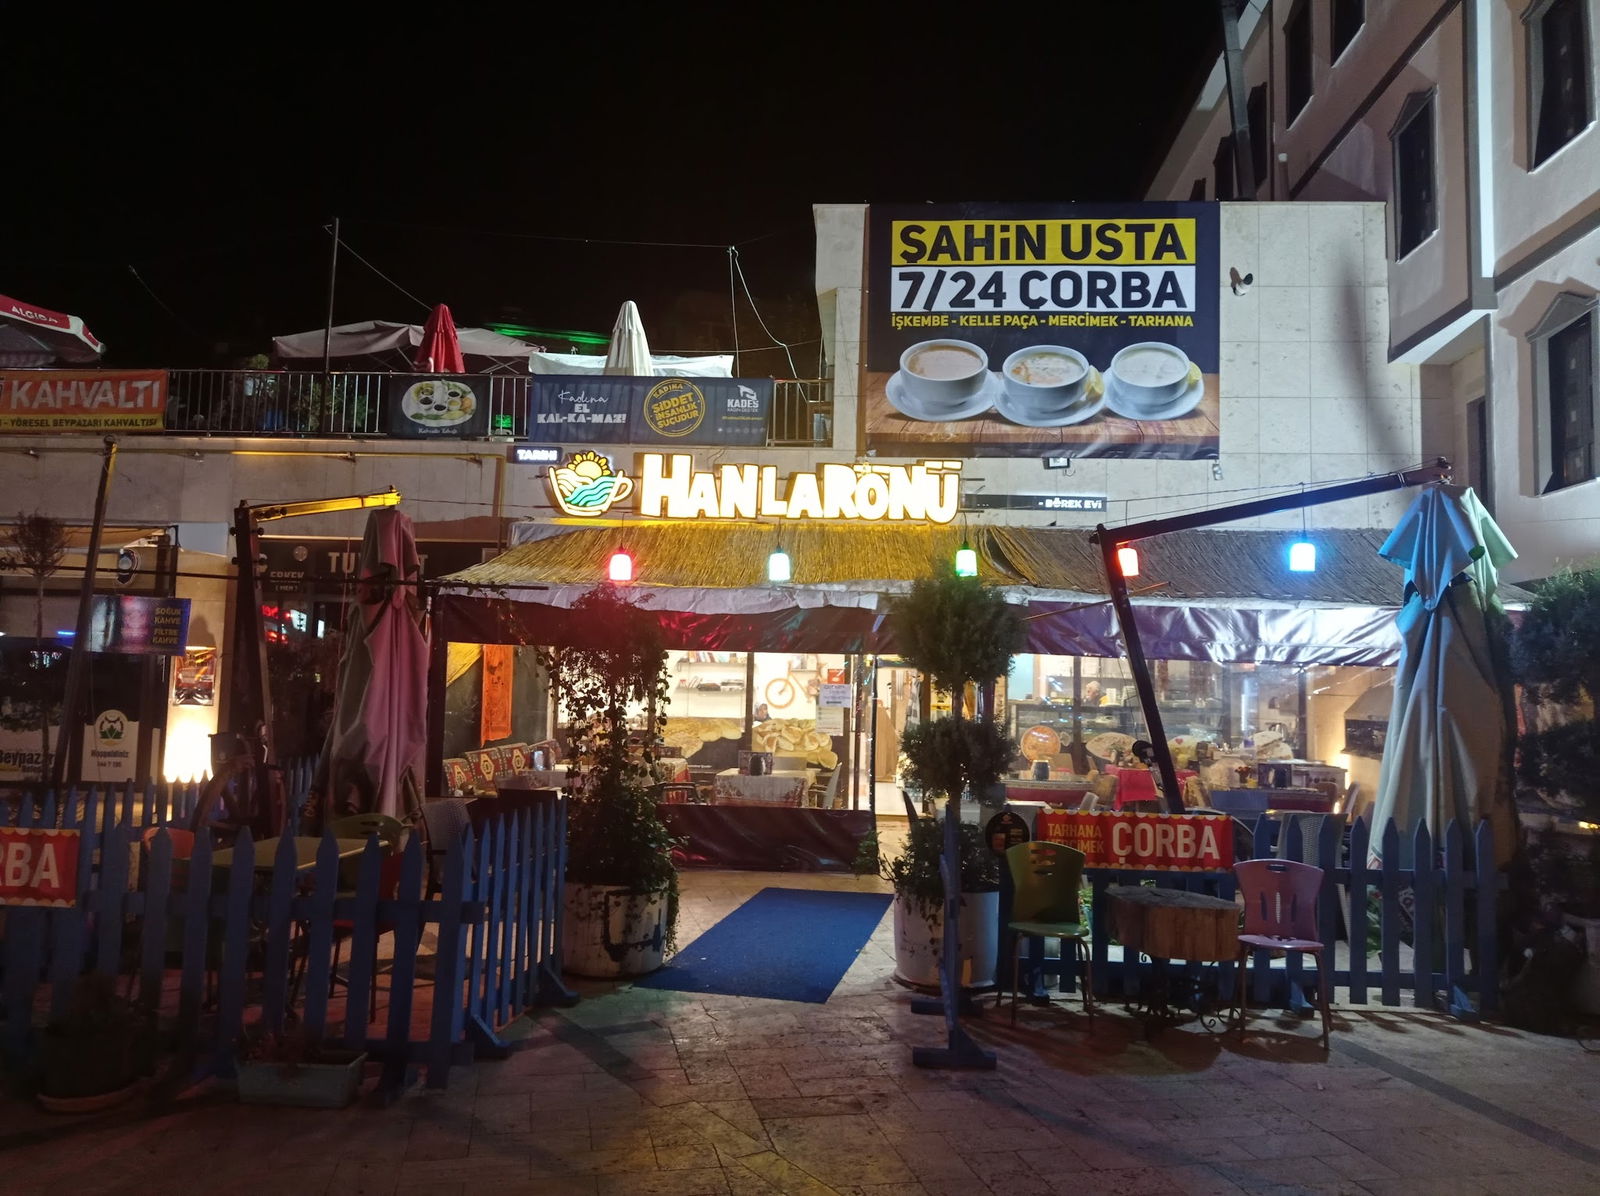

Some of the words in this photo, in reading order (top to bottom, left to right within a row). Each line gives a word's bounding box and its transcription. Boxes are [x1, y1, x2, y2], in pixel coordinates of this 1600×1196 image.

[1061, 223, 1187, 261] USTA
[898, 269, 1007, 311] 7/24
[1019, 270, 1187, 309] ÇORBA
[891, 313, 949, 330] İŞKEMBE
[959, 315, 1001, 327] KELLE
[1003, 315, 1038, 329] PAÇA
[1048, 313, 1118, 327] MERCİMEK
[1128, 315, 1194, 327] TARHANA
[10, 379, 161, 409] KAHVALTI
[574, 403, 590, 413] EL
[727, 399, 759, 408] KADES
[10, 417, 50, 427] YÖRESEL
[1047, 823, 1103, 838] TARHANA
[1112, 821, 1221, 864] ÇORBA
[0, 842, 60, 888] BA
